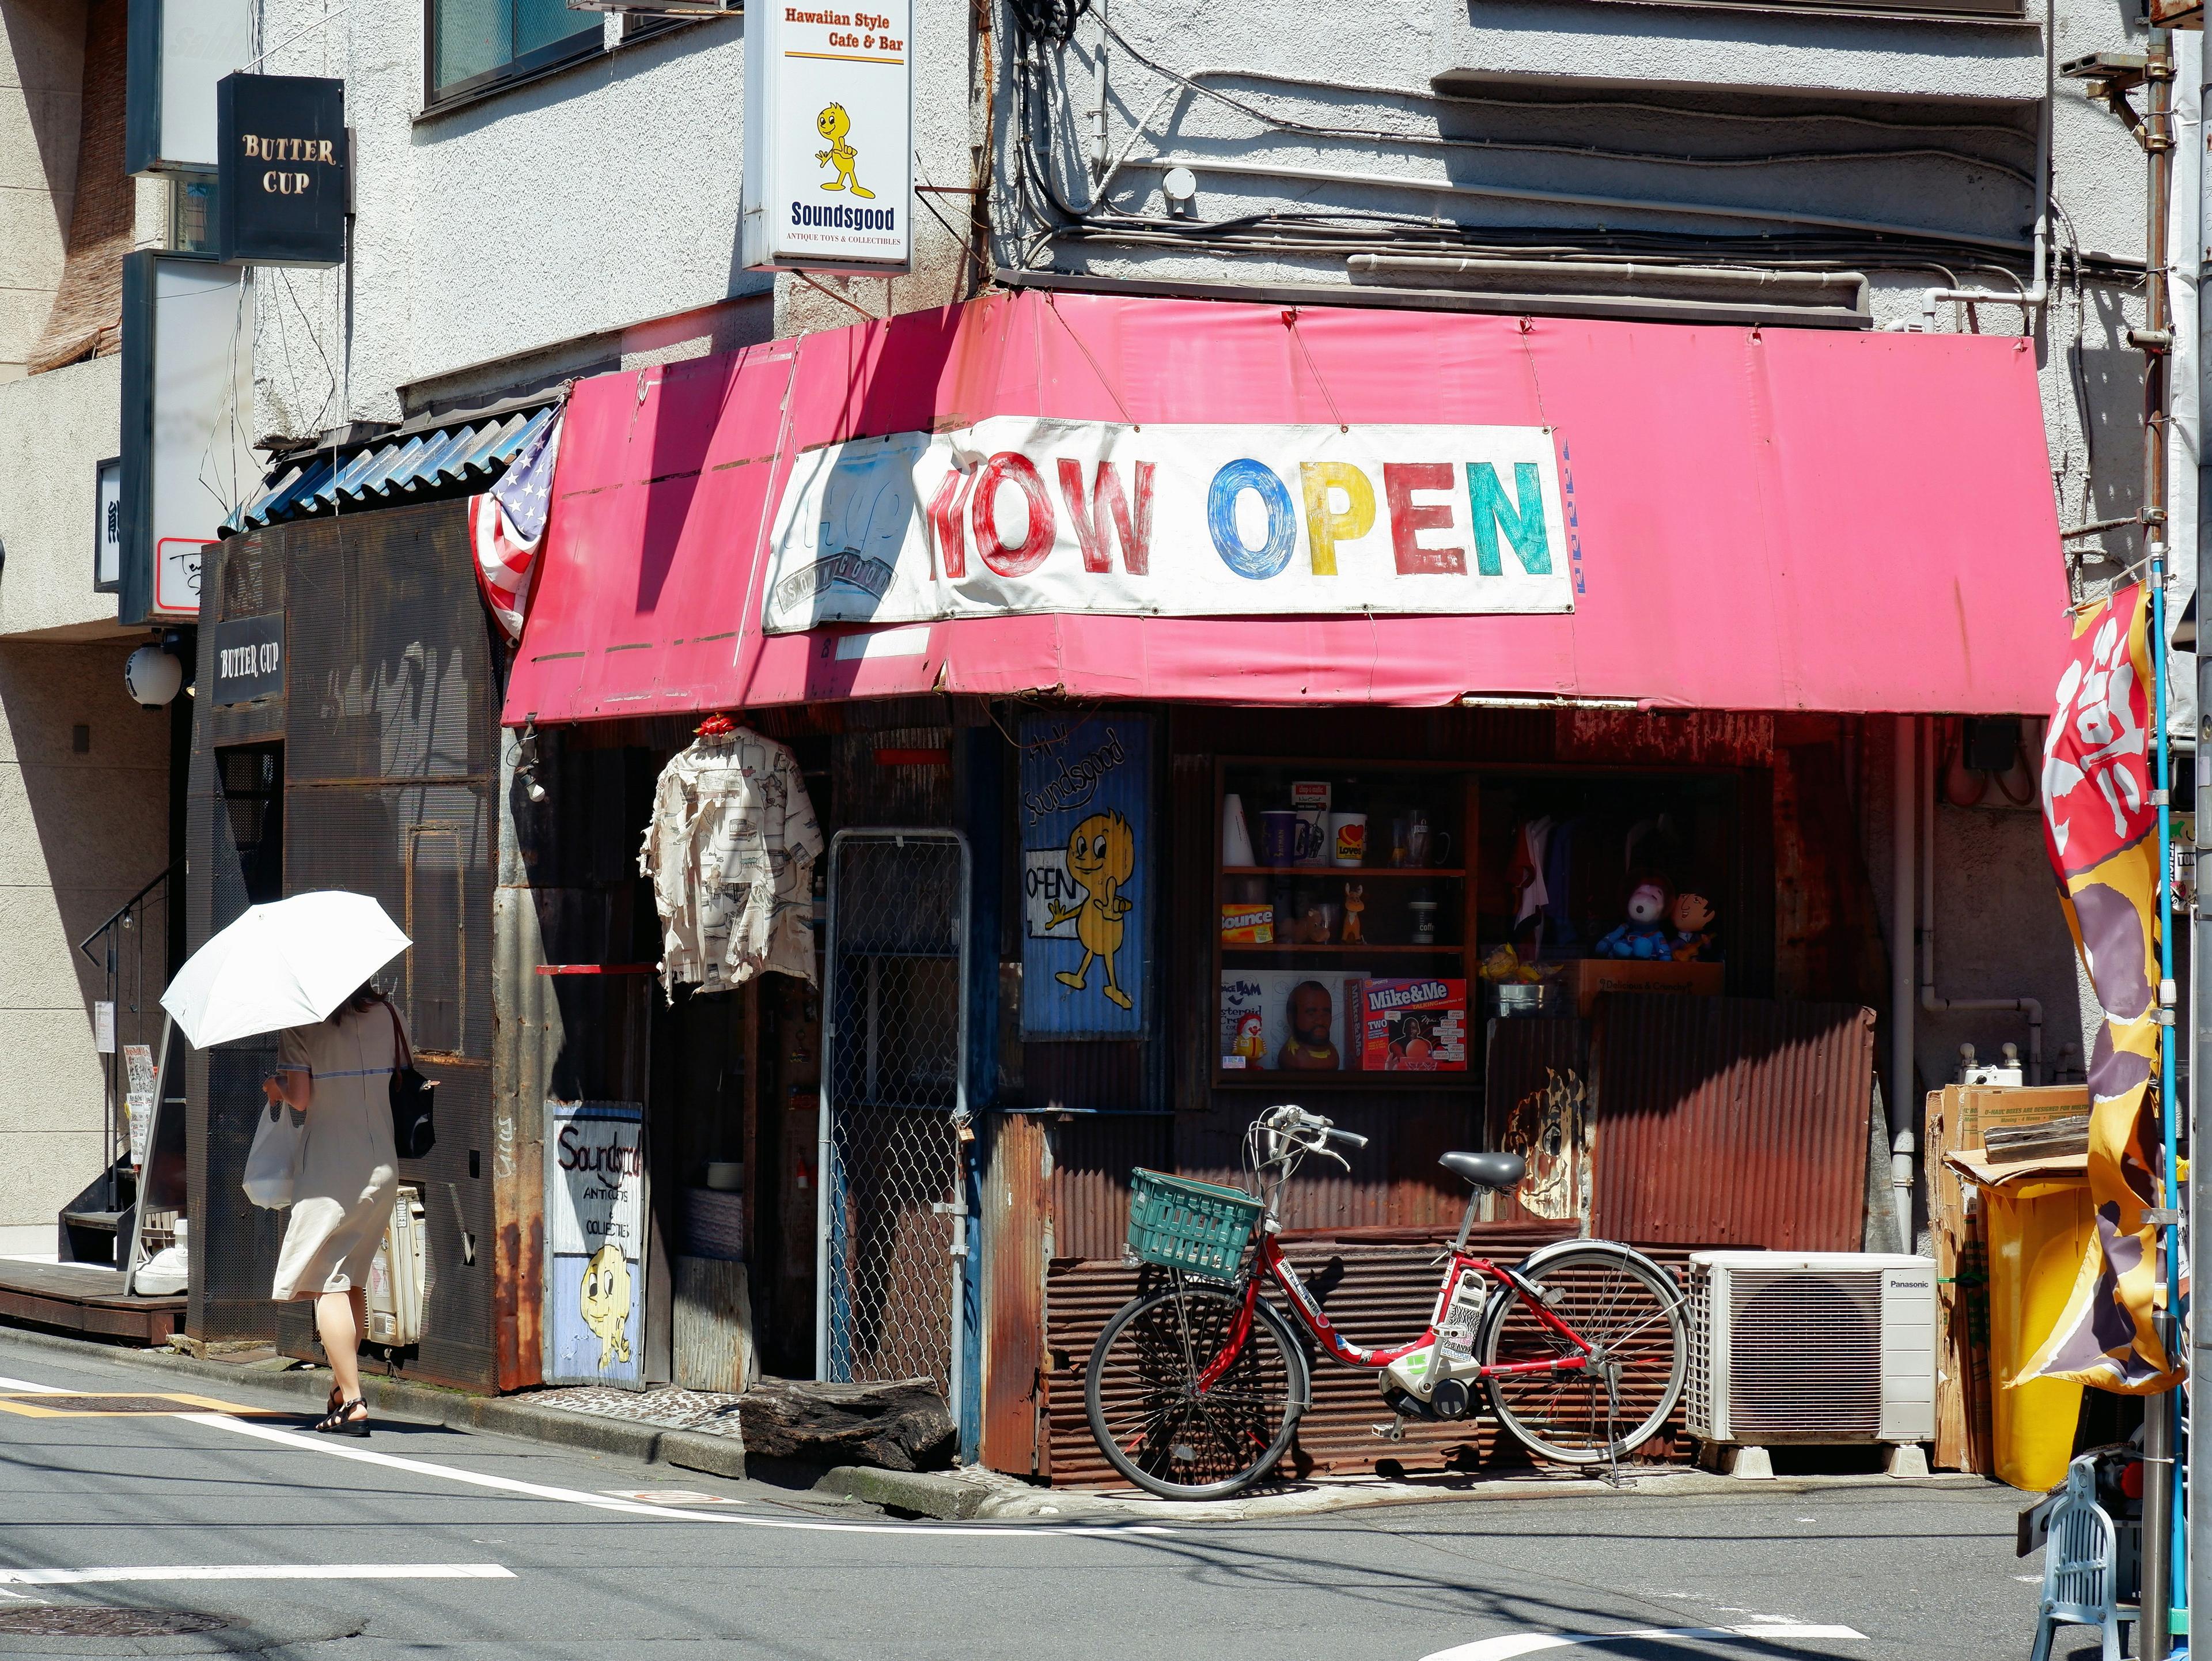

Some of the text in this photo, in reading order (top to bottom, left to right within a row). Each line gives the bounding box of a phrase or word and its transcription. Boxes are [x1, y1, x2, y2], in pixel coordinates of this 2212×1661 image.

[785, 8, 890, 31] Hawaiian Style
[829, 32, 903, 51] Cafe & Bar
[242, 134, 336, 165] BUTTER
[263, 171, 310, 195] CUP
[791, 202, 895, 231] Soundsgood
[786, 232, 901, 245] ANTIQUE TOYS & COLLECTIBLES
[1207, 458, 1554, 581] OPEN
[221, 641, 279, 679] BUTTER CUP
[1368, 1019, 1388, 1030] TWO
[1280, 1261, 1293, 1276] WHAT
[1890, 1280, 1929, 1289] Panasonic
[1442, 1348, 1470, 1360] WELCOME
